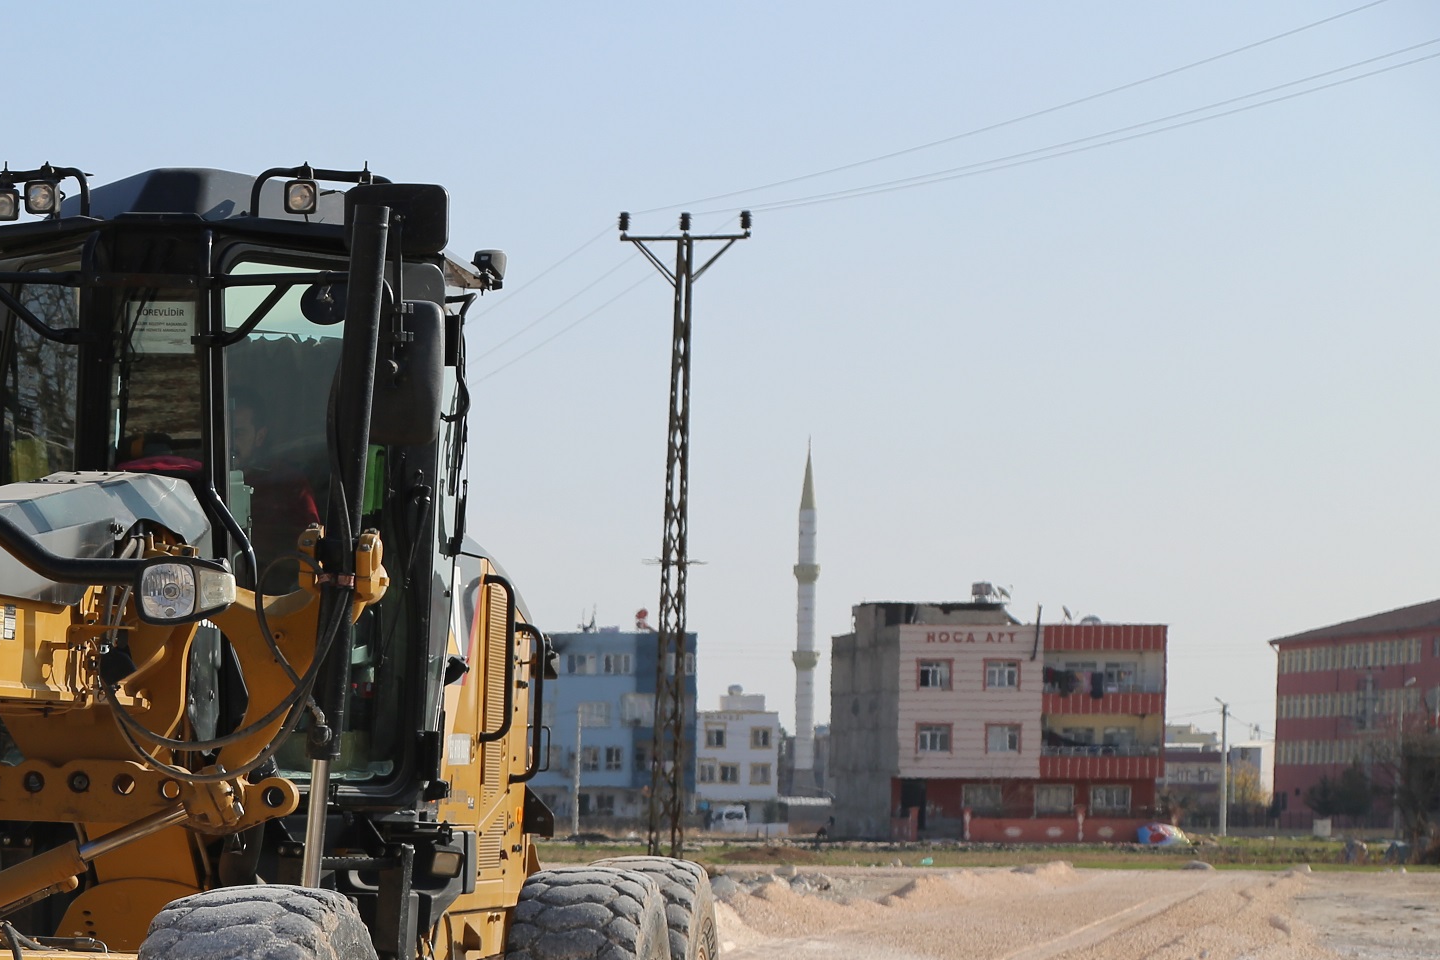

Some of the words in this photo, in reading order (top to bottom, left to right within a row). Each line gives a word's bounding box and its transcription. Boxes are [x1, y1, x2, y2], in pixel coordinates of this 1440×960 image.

[137, 307, 185, 317] ÖREVLİDİR
[926, 631, 976, 644] HOCA
[985, 631, 1017, 644] APT
